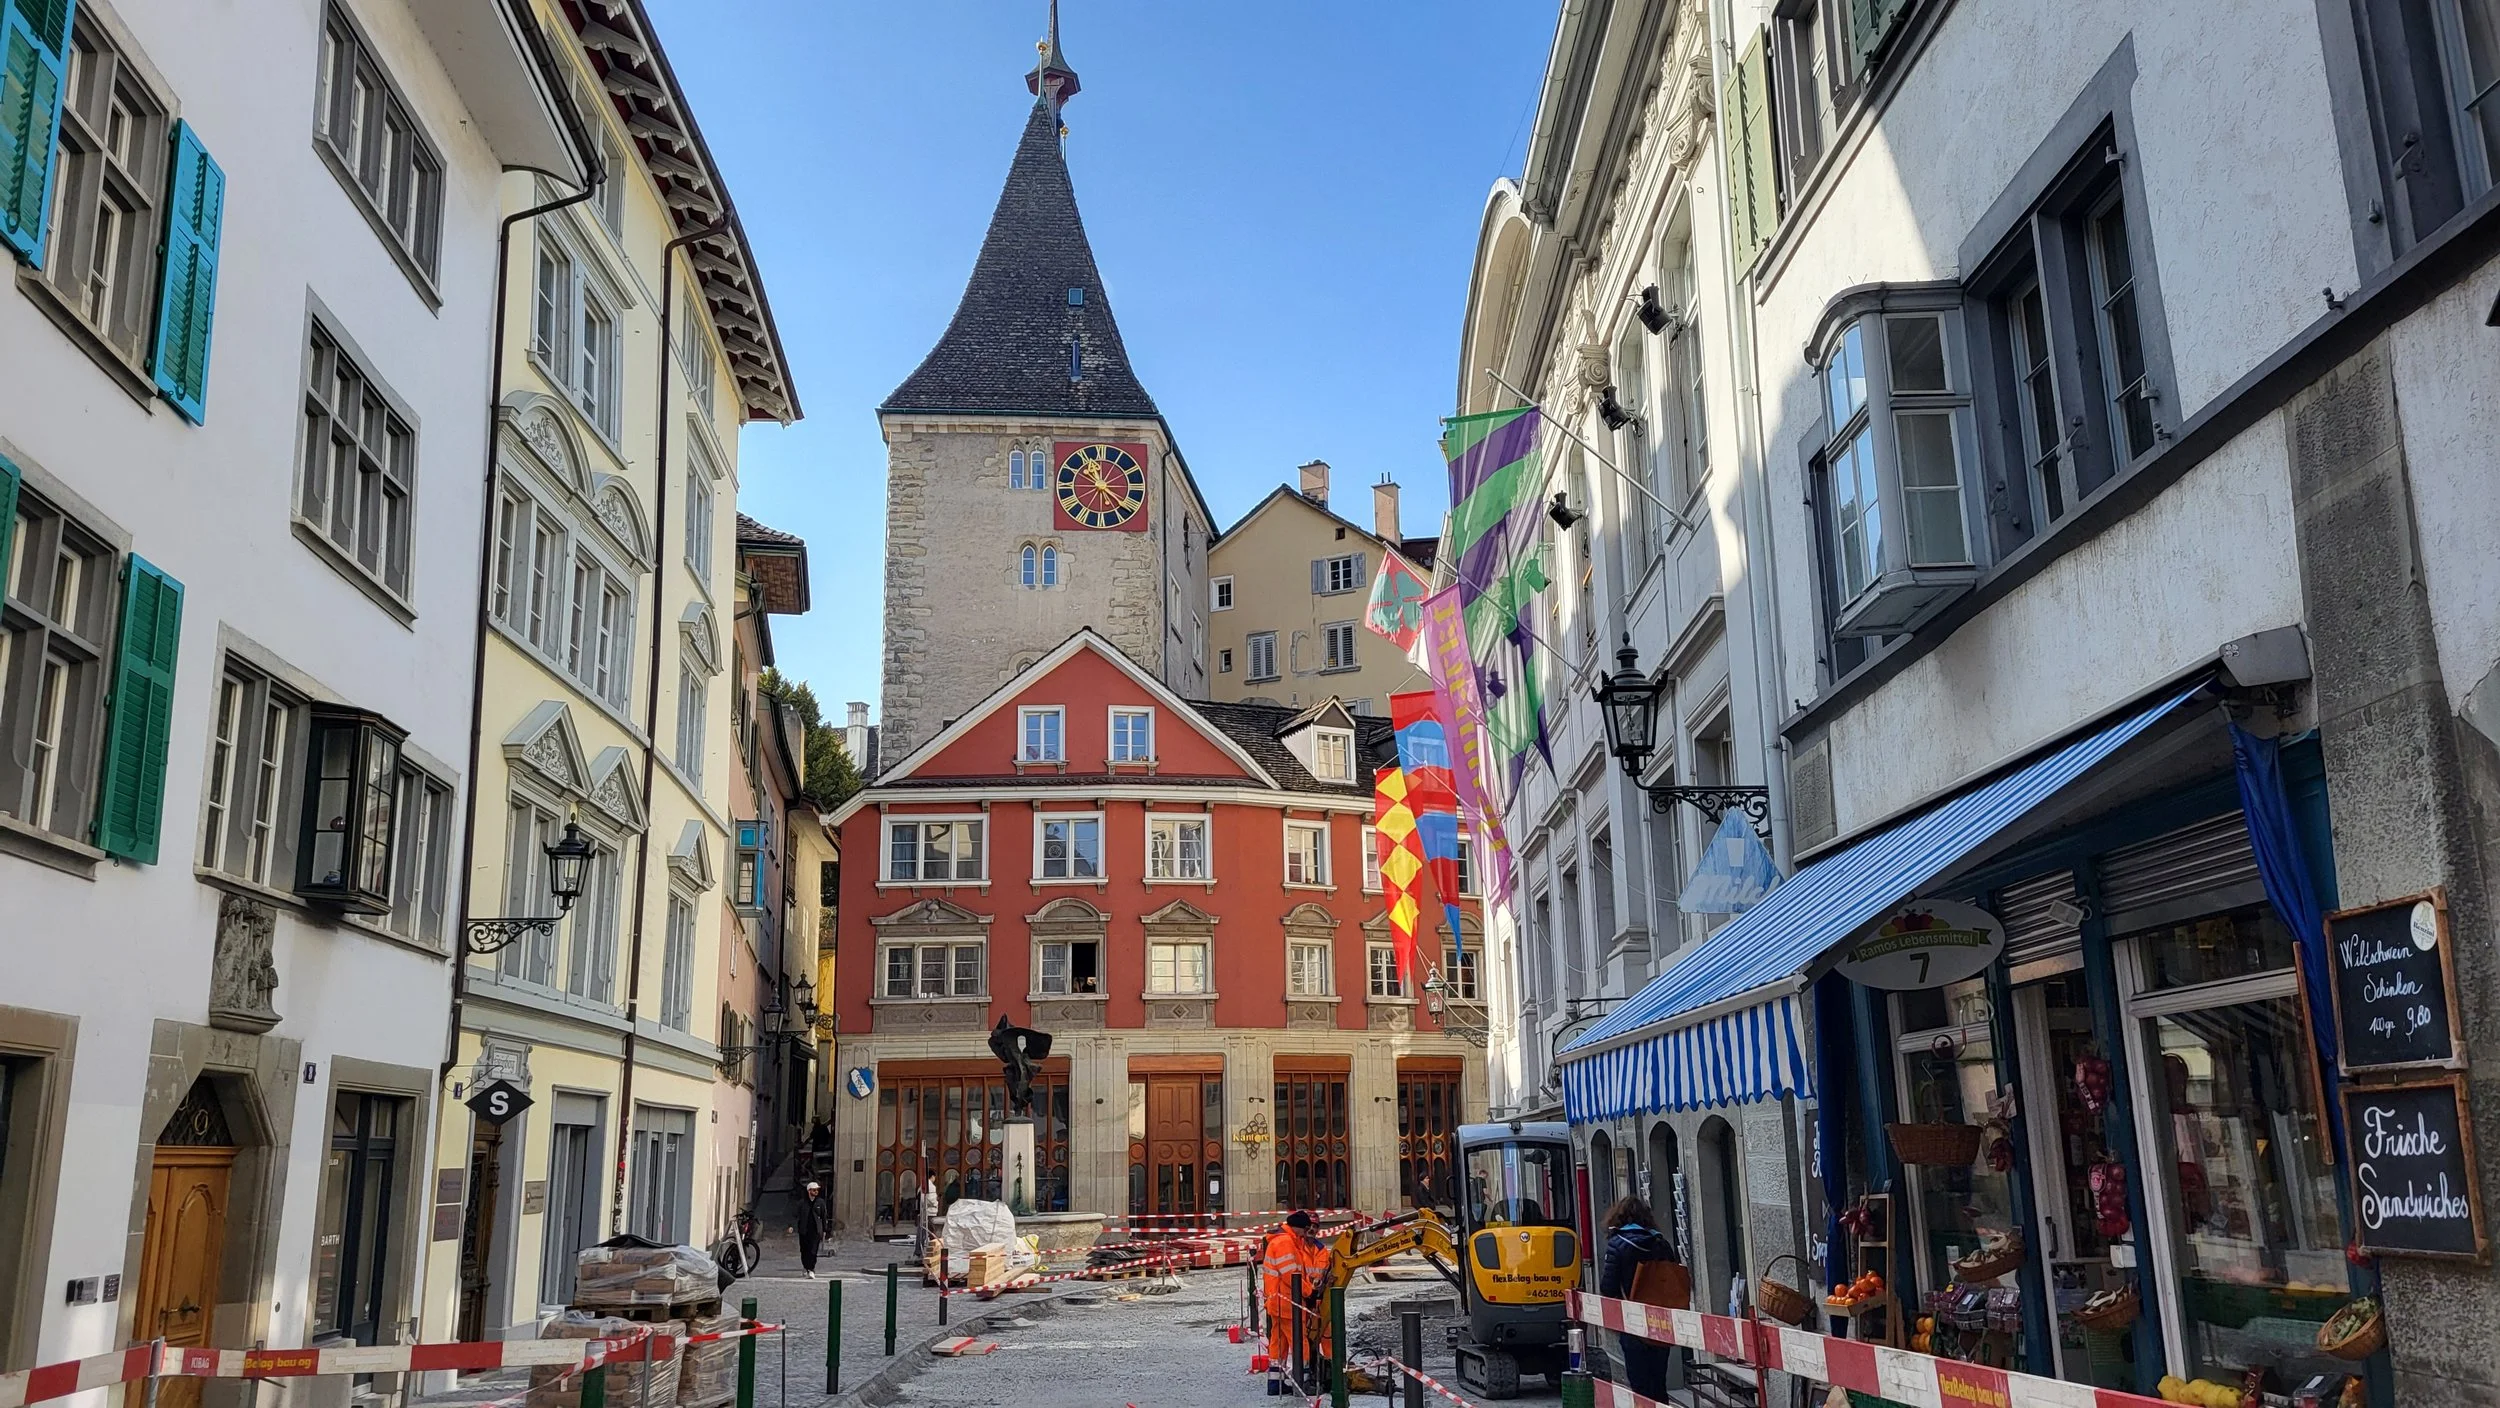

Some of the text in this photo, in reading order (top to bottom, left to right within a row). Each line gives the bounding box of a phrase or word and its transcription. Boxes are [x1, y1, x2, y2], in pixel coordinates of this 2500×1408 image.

[1859, 932, 1974, 960] Ramos Lebensmittel
[2340, 933, 2413, 970] Wildschwein
[1909, 952, 1930, 984] 7
[2364, 971, 2424, 1003] Schinken
[2406, 1004, 2432, 1038] 9.80
[489, 1091, 509, 1116] S
[2363, 1106, 2447, 1158] Frische
[2358, 1162, 2469, 1230] Sandwiches
[1532, 1289, 1564, 1297] 462186
[1533, 1273, 1549, 1282] bau
